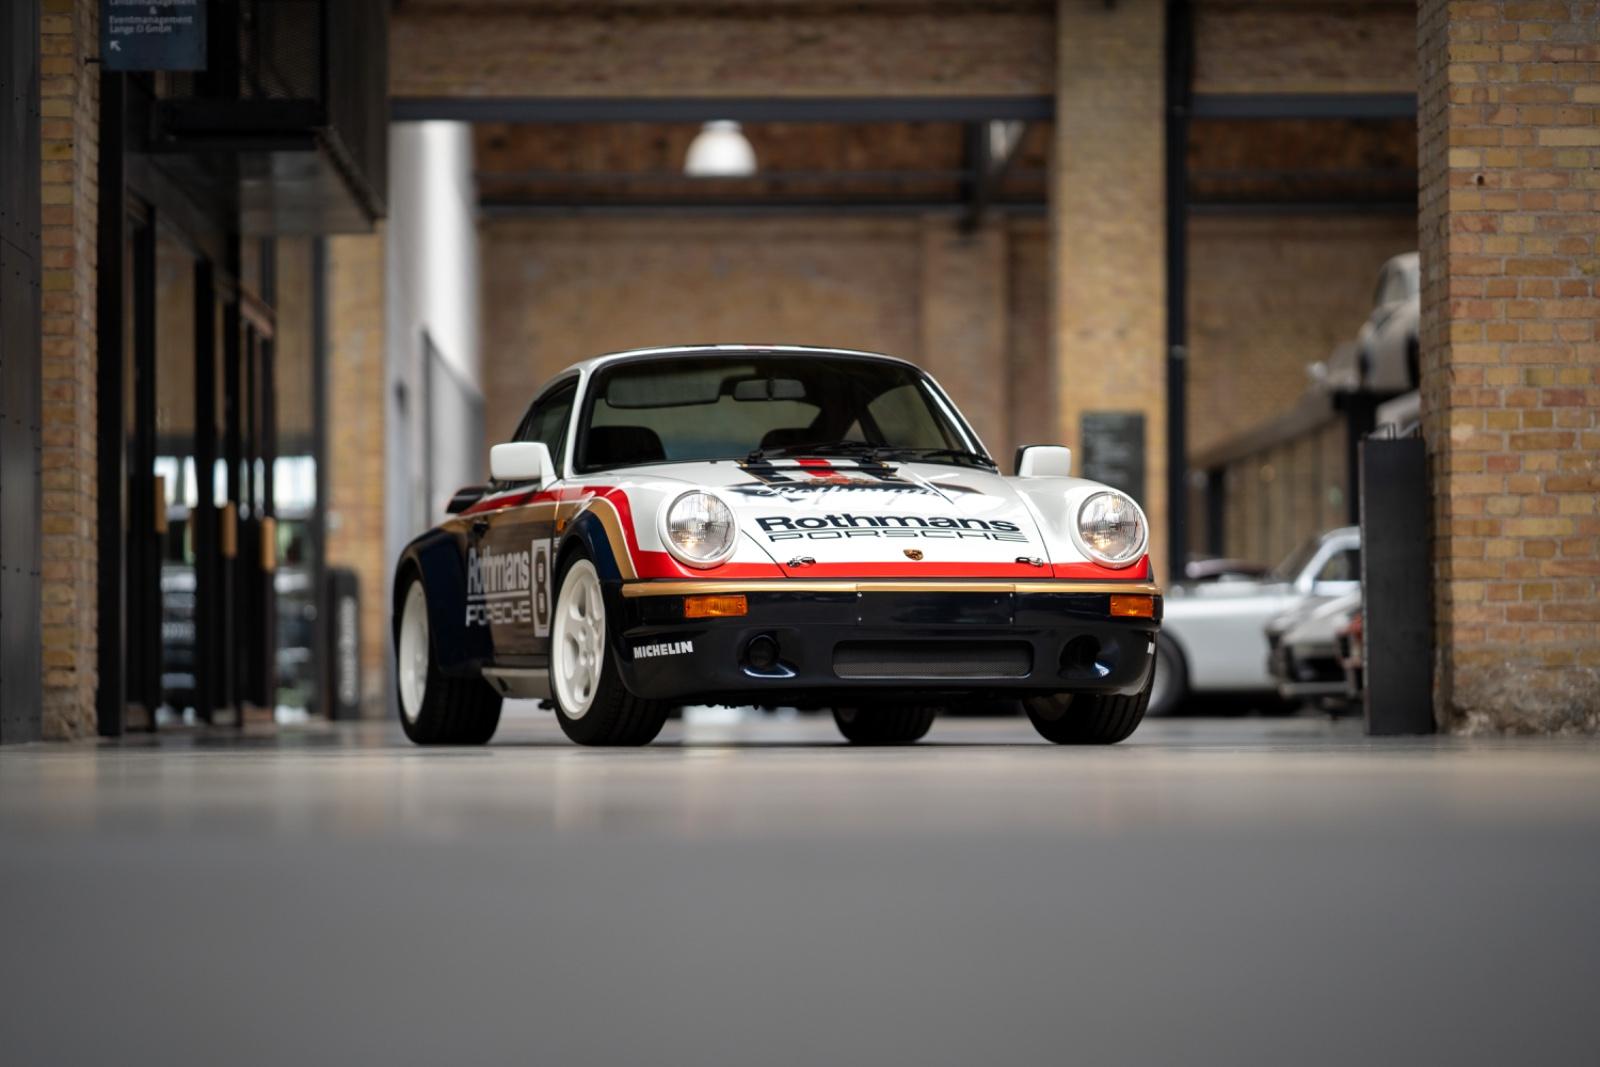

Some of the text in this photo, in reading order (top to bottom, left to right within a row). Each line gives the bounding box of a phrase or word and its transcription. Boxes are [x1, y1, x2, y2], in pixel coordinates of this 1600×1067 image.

[755, 513, 1021, 532] Rothmans
[767, 530, 1029, 543] PORSCHE
[467, 545, 531, 594] Rothmans
[465, 600, 531, 627] PORSCHE
[633, 640, 693, 659] MICHELIN
